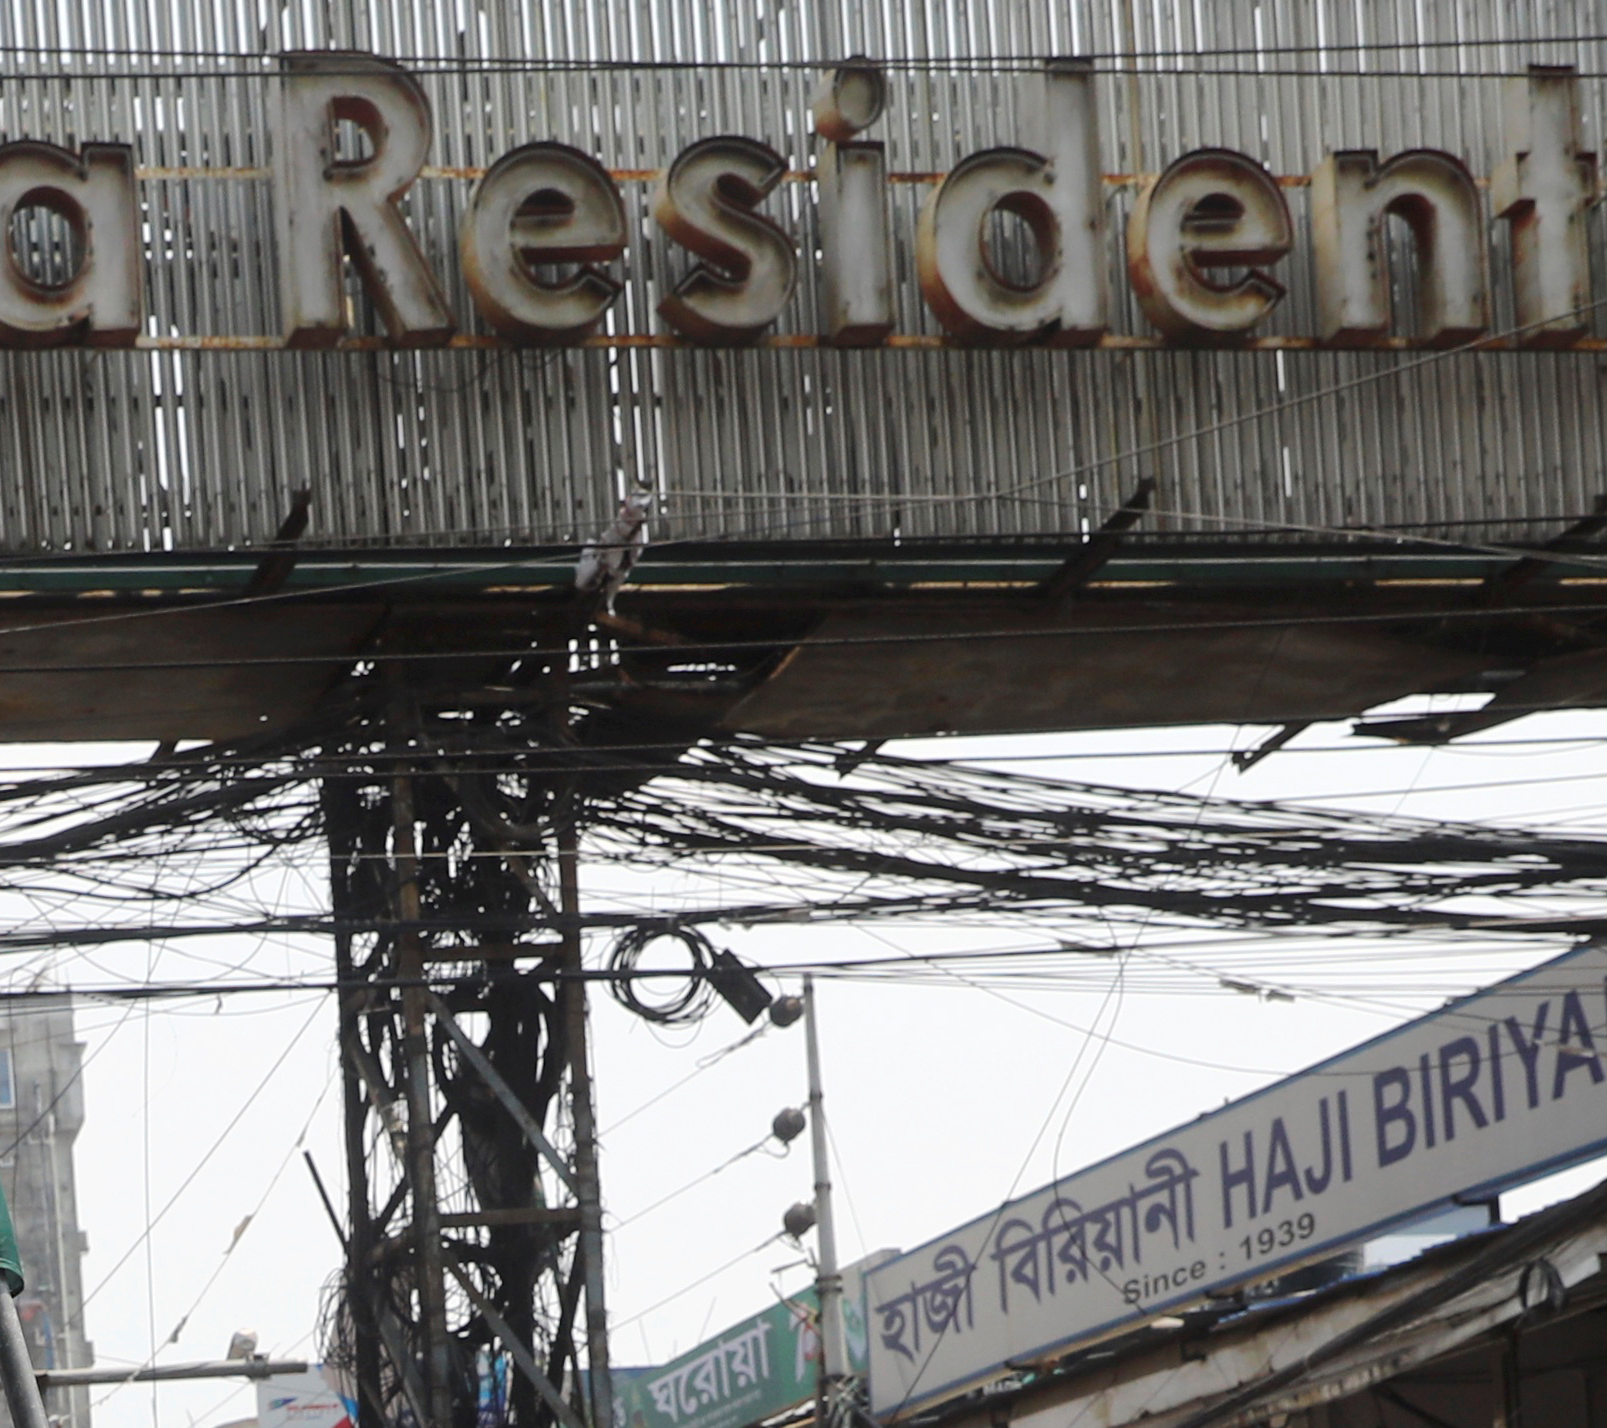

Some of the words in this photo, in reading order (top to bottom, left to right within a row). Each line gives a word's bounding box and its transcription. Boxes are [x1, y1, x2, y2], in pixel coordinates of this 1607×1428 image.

[1219, 1088, 1355, 1231] HAJI
[874, 1244, 978, 1361] হাজী
[990, 1147, 1201, 1315] বিরিয়ানী
[1122, 1255, 1207, 1304] Since
[1239, 1211, 1317, 1262] 1939
